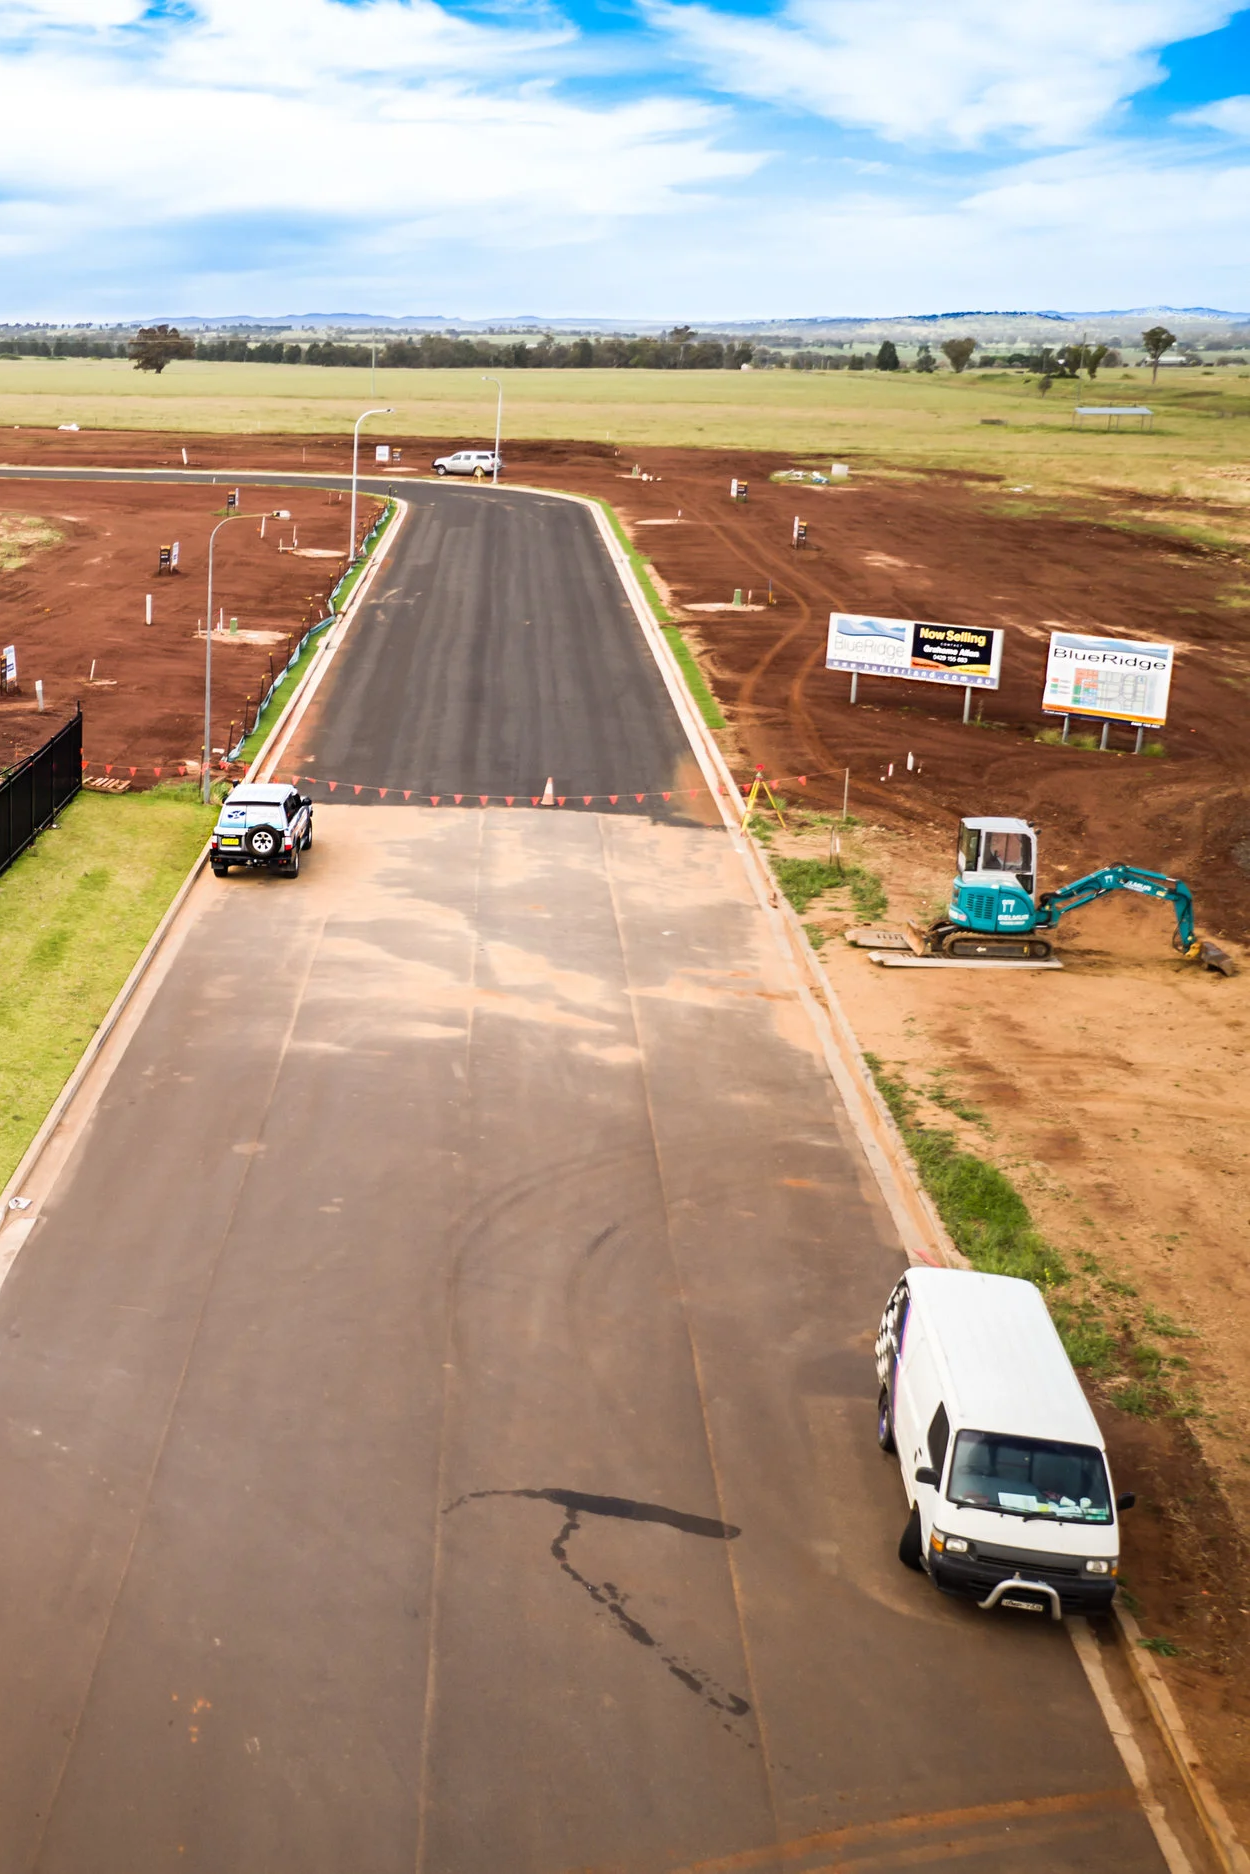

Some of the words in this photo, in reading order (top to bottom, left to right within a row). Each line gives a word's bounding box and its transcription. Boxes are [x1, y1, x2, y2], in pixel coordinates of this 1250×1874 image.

[834, 635, 906, 658] BlueRidge
[919, 627, 946, 640] Now
[946, 629, 987, 647] Selling
[1053, 648, 1166, 670] BlueRidge
[833, 660, 991, 685] www.hunterland.com.au
